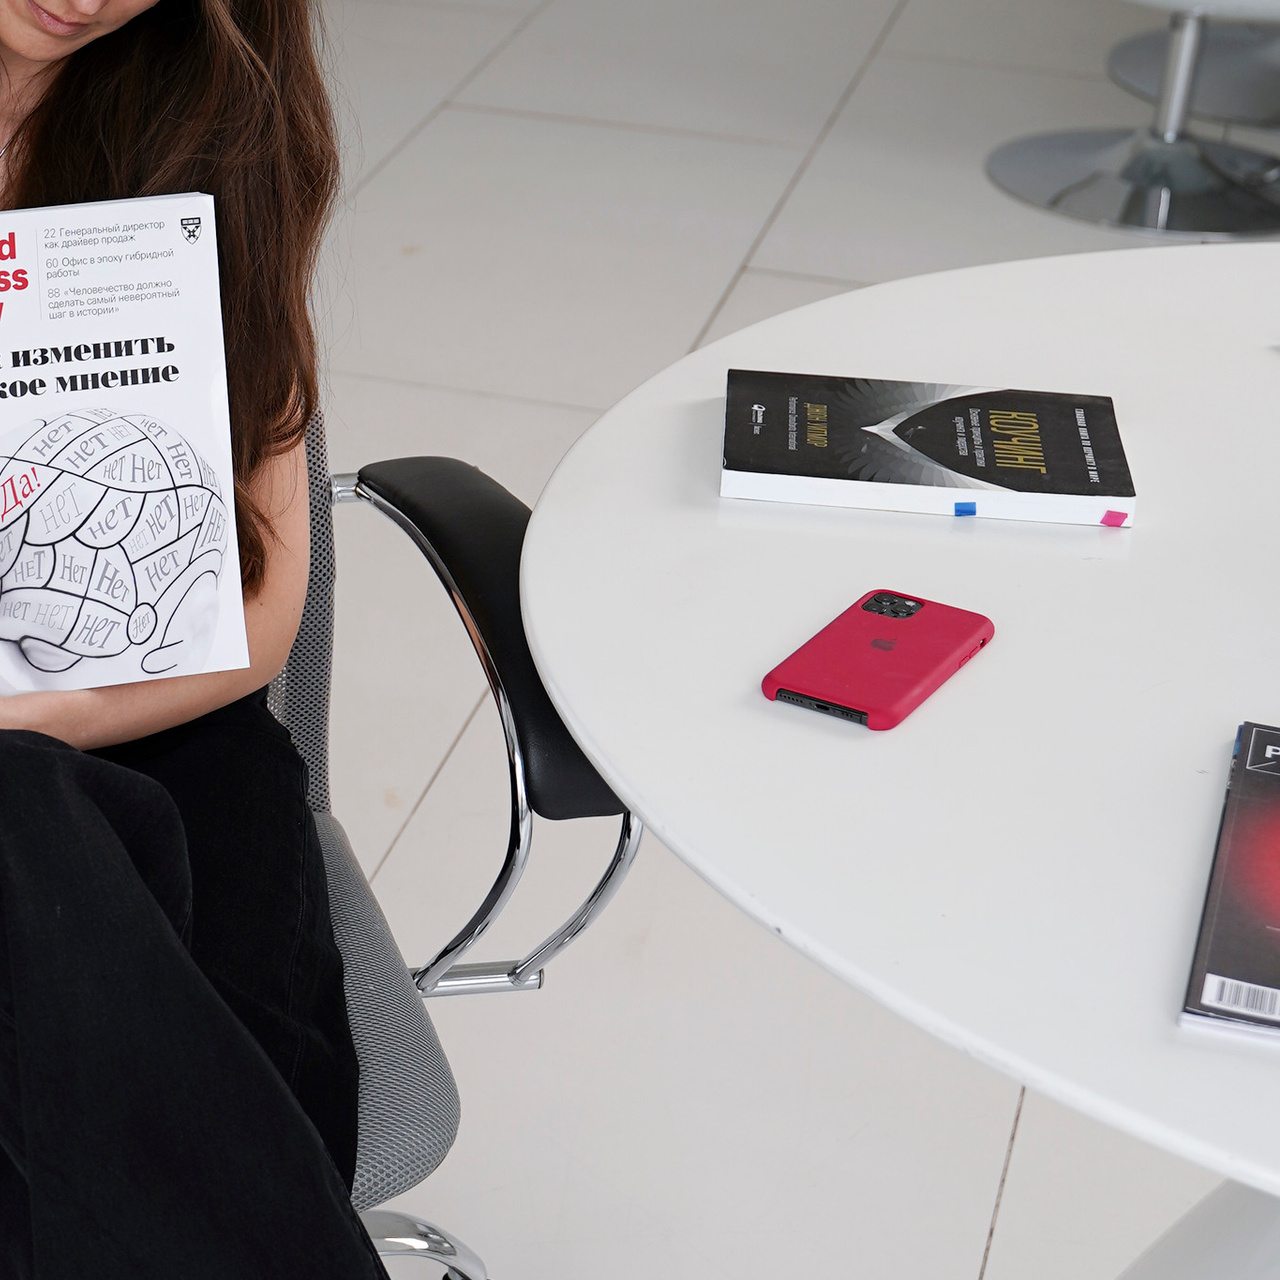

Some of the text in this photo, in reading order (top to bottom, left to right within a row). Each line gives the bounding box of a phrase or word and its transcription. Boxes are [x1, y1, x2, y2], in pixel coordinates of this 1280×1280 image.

[44, 221, 165, 238] 22 Генеральный директор
[45, 234, 136, 249] как драйвер продаж
[46, 258, 58, 268] 60
[62, 256, 88, 267] Офис
[97, 255, 123, 264] эпоху
[125, 248, 174, 260] гибридной
[46, 268, 80, 280] работы
[48, 280, 172, 298] 88 «Человечество должно
[48, 288, 180, 309] сделать самый невероятный
[49, 306, 119, 320] шаг в истории»
[10, 336, 175, 368] изменить
[55, 364, 180, 394] мнение
[989, 410, 1047, 474] КОУЧИНГ
[0, 467, 40, 522] Да!
